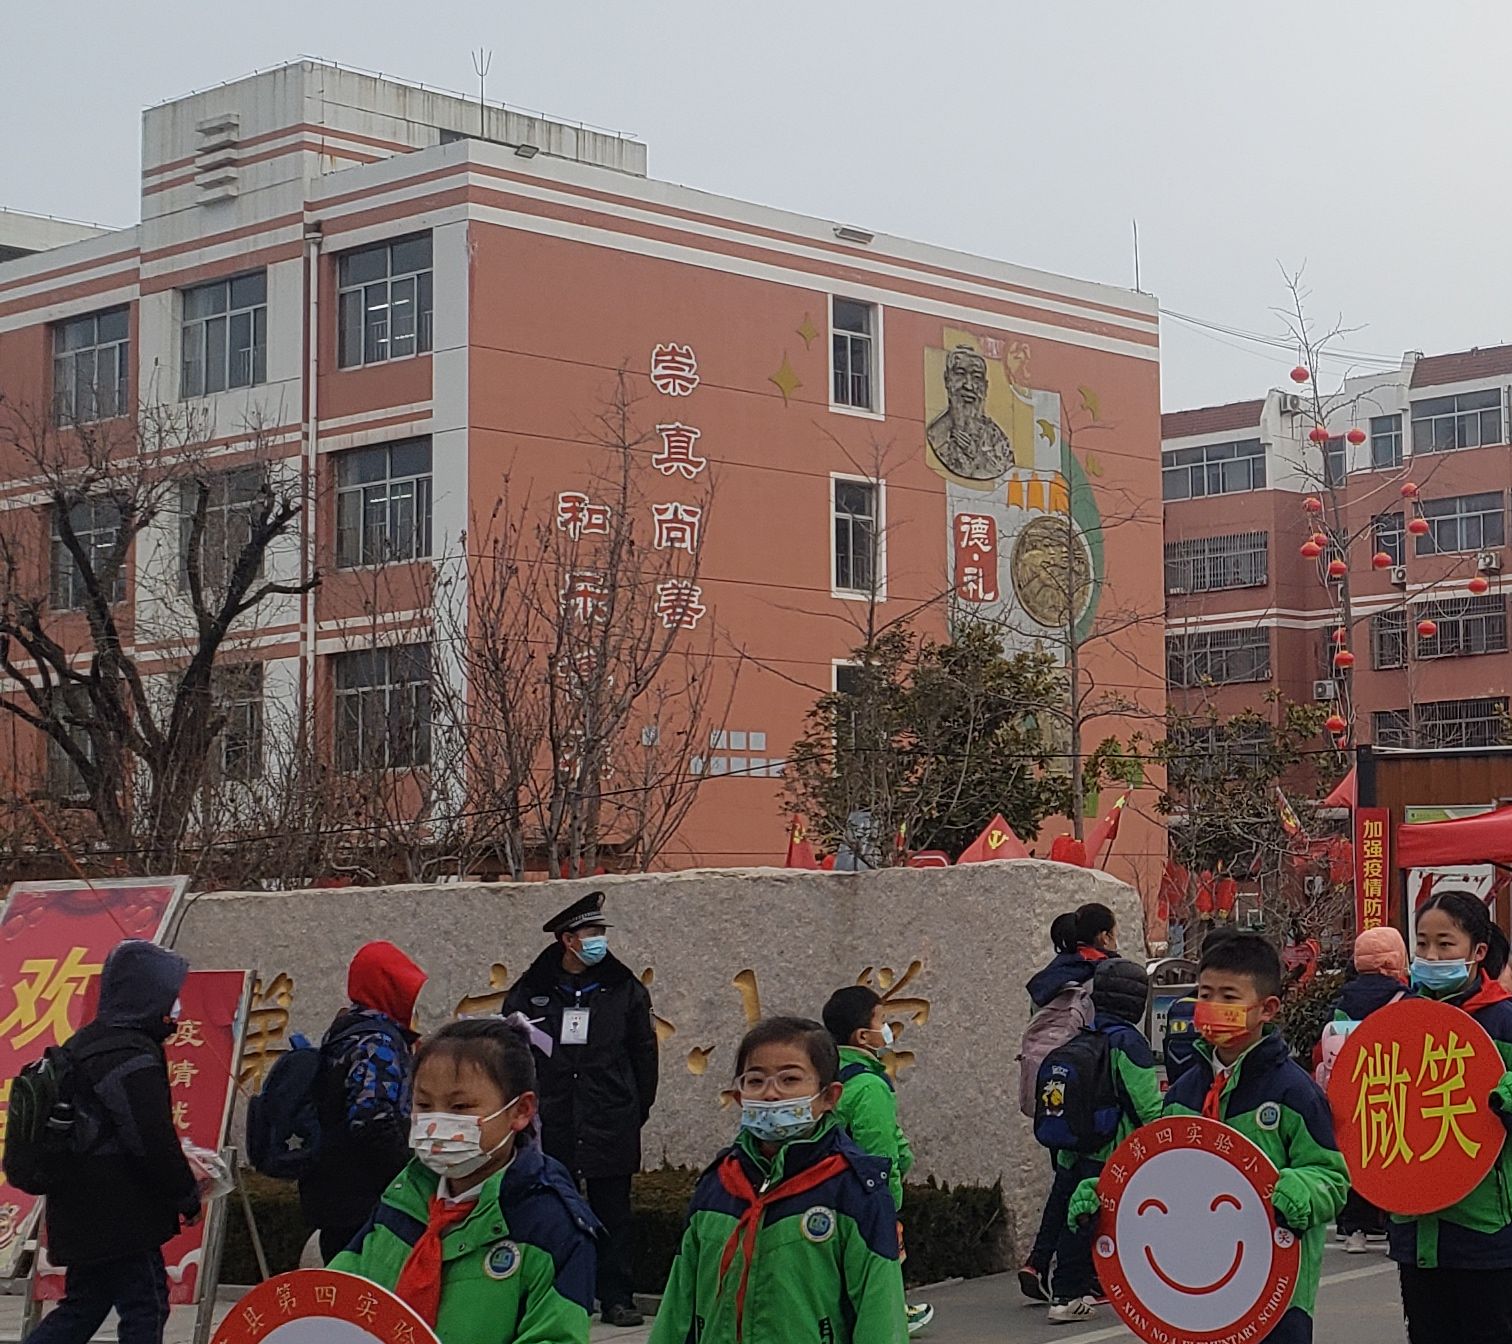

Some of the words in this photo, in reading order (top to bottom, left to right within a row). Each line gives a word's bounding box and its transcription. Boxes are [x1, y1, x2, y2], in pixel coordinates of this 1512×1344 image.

[651, 342, 706, 630] 崇真尚善
[1362, 819, 1383, 930] 加强疫情防控
[1351, 1030, 1481, 1169] 微笑
[1110, 1283, 1125, 1299] JU
[1122, 1302, 1149, 1331] XIAN
[1258, 1275, 1290, 1325] SCHOOL
